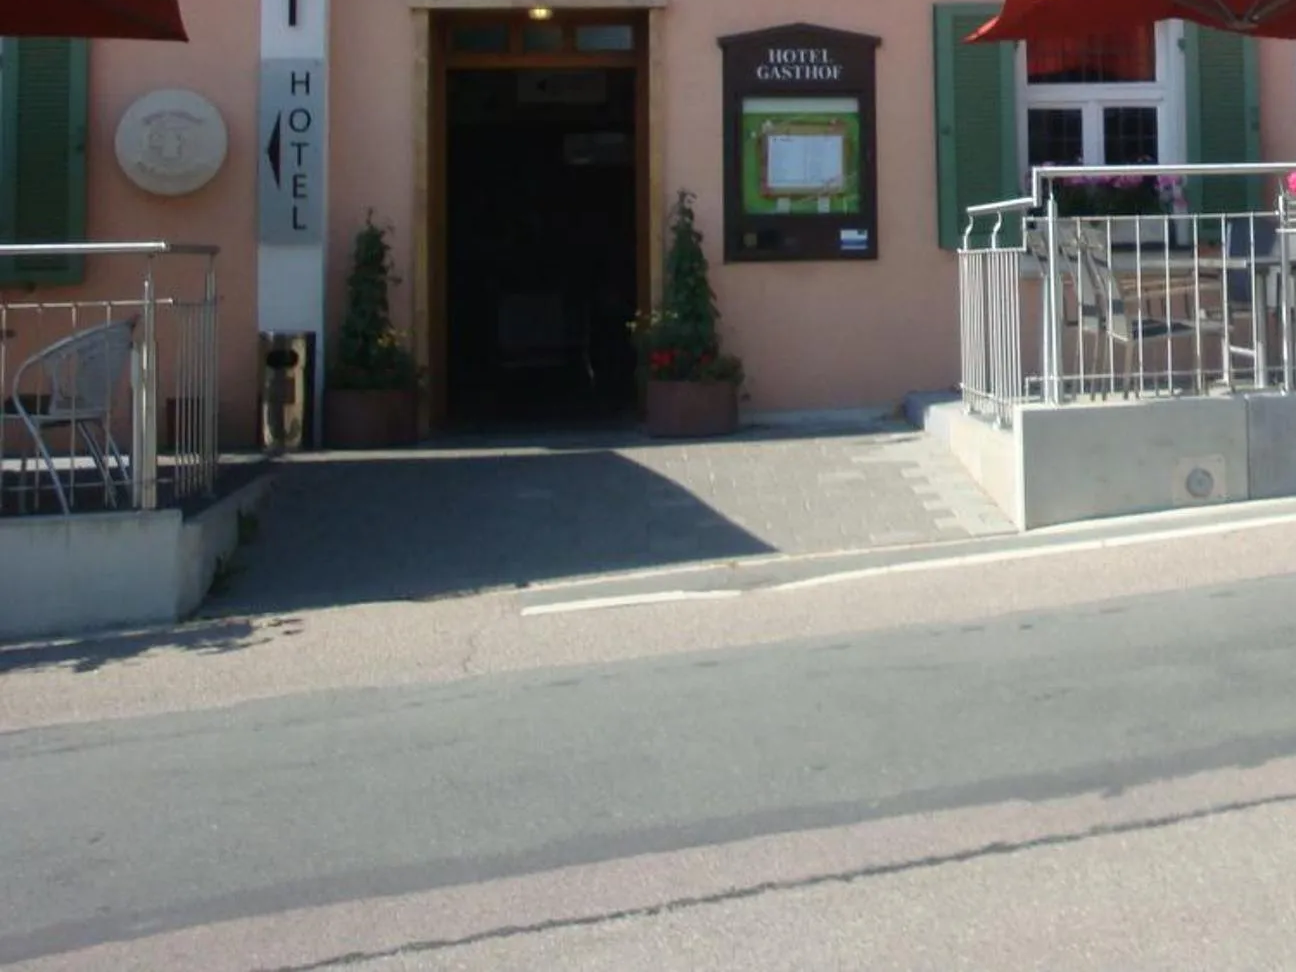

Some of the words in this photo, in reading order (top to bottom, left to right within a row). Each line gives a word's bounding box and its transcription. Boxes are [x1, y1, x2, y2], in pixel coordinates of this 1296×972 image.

[768, 48, 831, 64] HOTEL
[756, 64, 843, 80] GASTHOF
[288, 71, 312, 231] HOTEL
